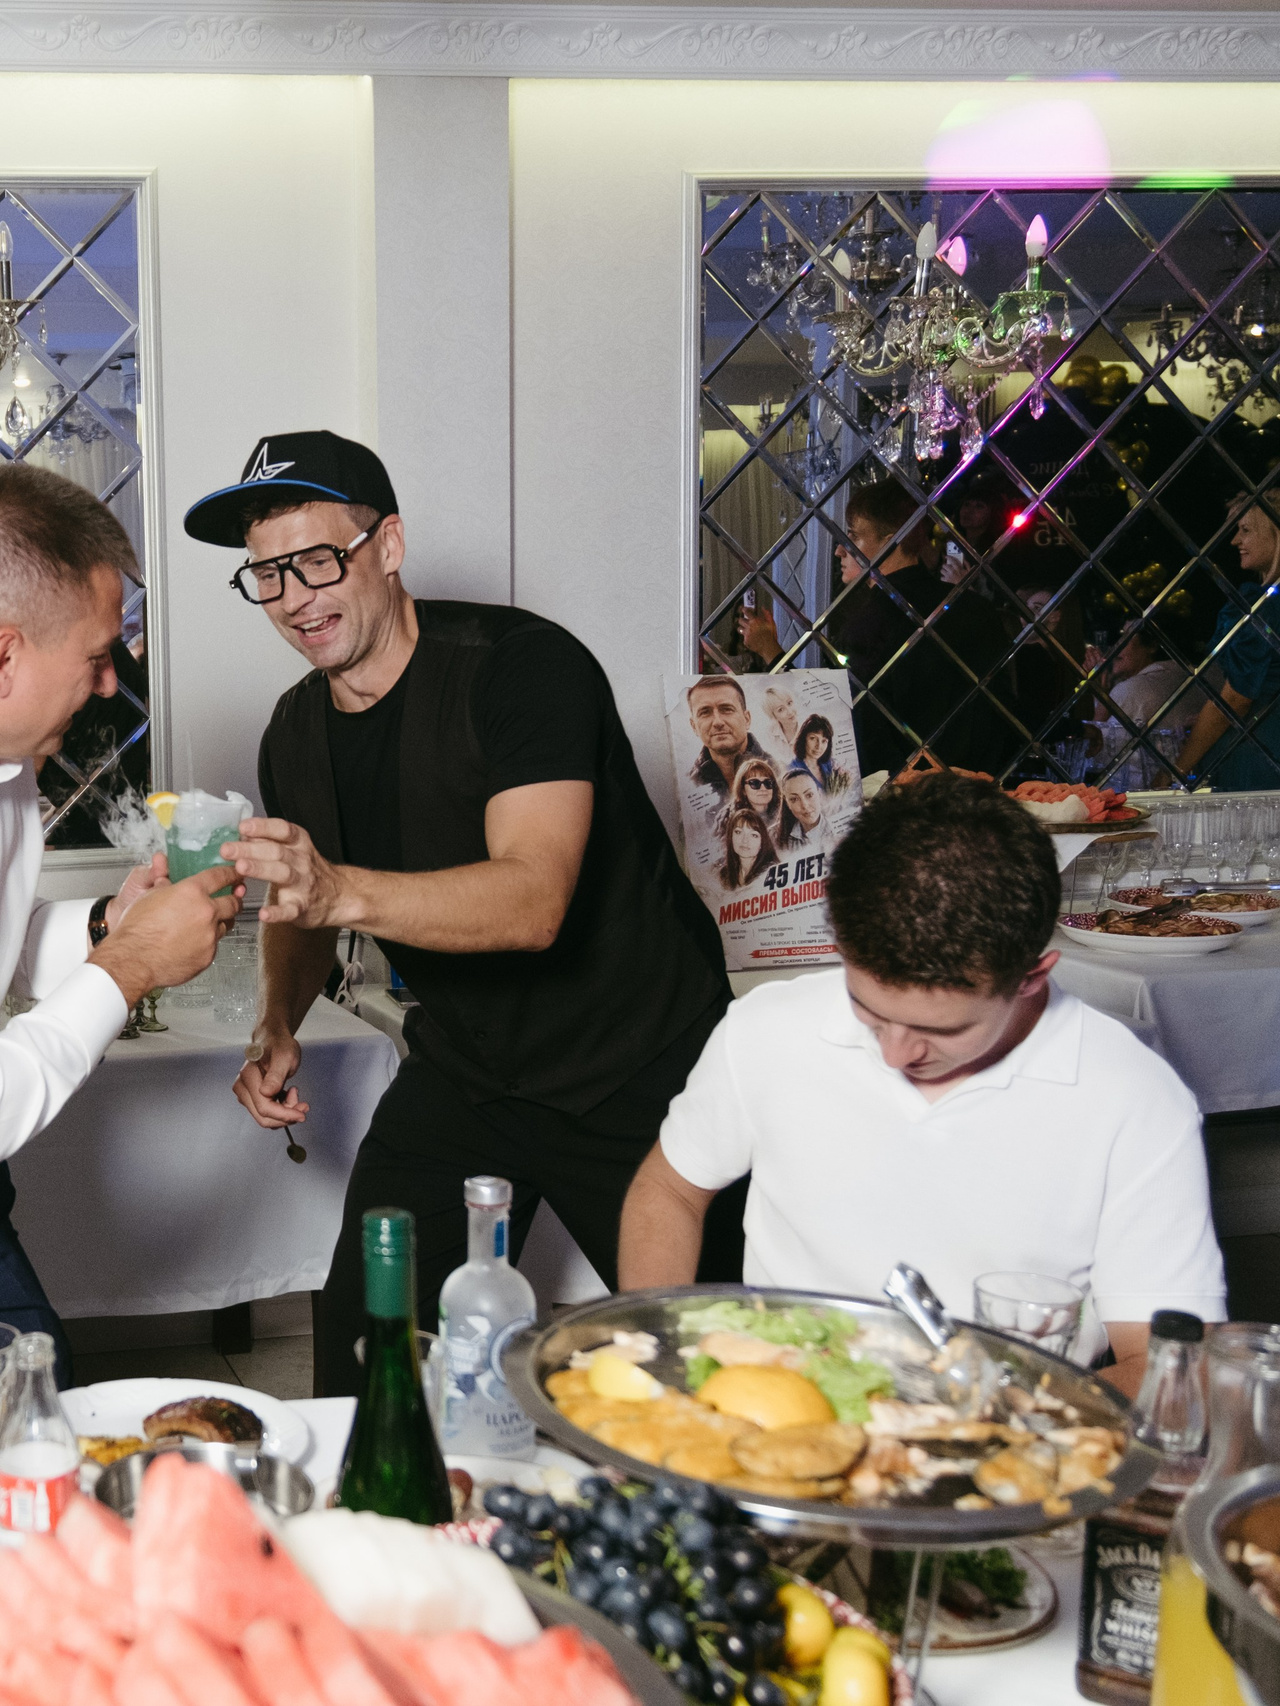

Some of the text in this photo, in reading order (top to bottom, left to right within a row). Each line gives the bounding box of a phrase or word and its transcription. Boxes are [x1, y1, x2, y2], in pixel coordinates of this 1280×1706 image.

[763, 852, 828, 891] 45 ЛЕТ.
[719, 878, 828, 926] МИССИЯ ВЫПОЛ
[759, 949, 789, 957] ПРЕМЬЕРА
